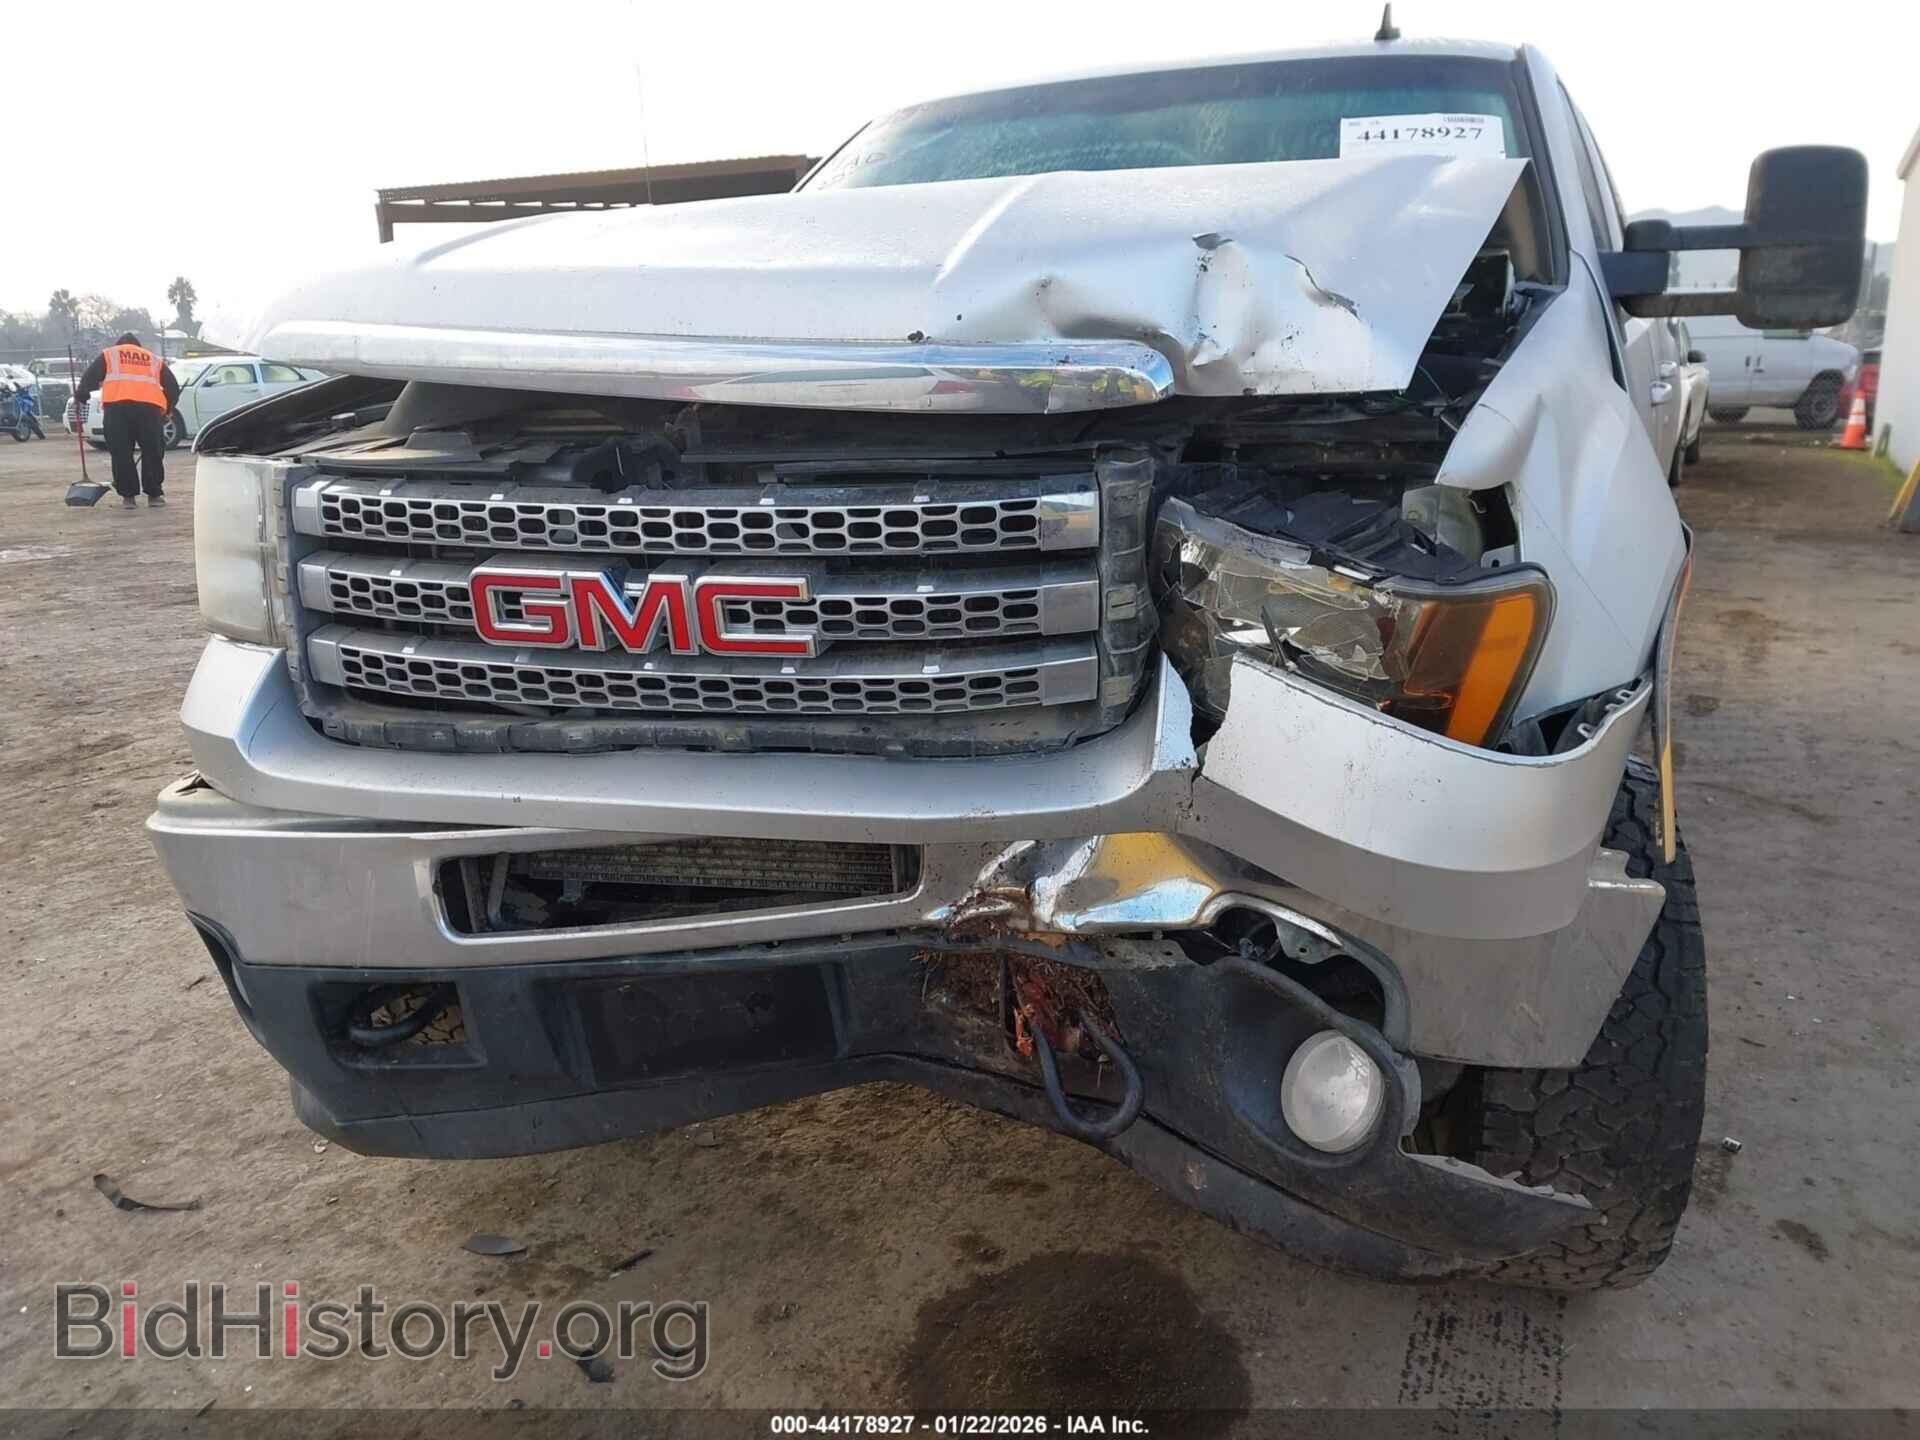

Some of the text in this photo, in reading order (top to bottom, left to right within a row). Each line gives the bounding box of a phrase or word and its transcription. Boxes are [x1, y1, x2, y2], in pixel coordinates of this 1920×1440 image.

[1357, 126, 1483, 141] 44178927
[119, 351, 151, 361] MAD
[470, 566, 816, 658] GMC
